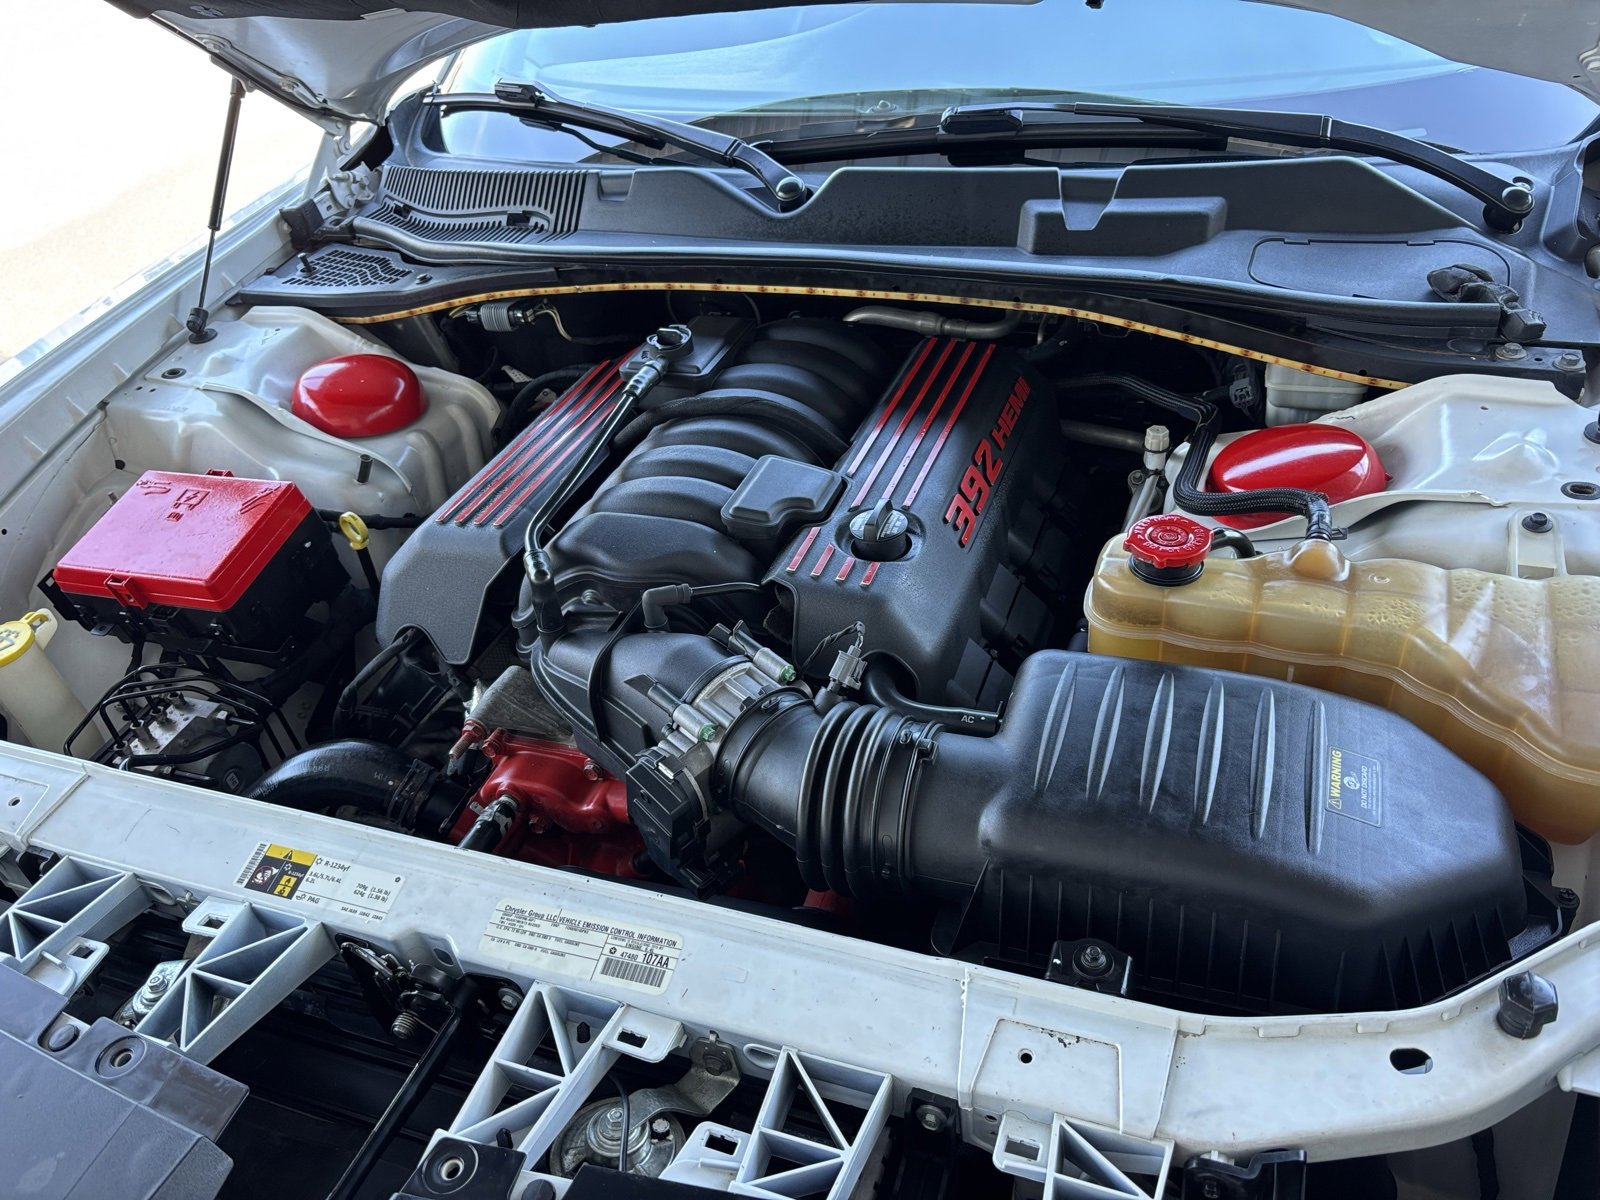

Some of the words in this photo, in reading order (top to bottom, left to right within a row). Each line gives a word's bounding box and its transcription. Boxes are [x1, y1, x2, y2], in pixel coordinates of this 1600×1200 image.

[943, 438, 1004, 547] 392
[991, 375, 1031, 450] HEMI
[961, 715, 975, 724] AC
[1330, 750, 1342, 798] WARNING
[1361, 799, 1368, 809] DO
[324, 860, 351, 872] R-1234yf
[307, 896, 320, 904] PAG
[504, 904, 527, 914] Chrysler
[528, 910, 545, 920] Group
[546, 914, 558, 922] LLC
[559, 916, 582, 927] VEHICLE
[582, 921, 610, 932] EMISSION
[610, 927, 636, 939] CONTROL
[637, 934, 678, 947] INFORMATION
[642, 952, 670, 968] 107AA
